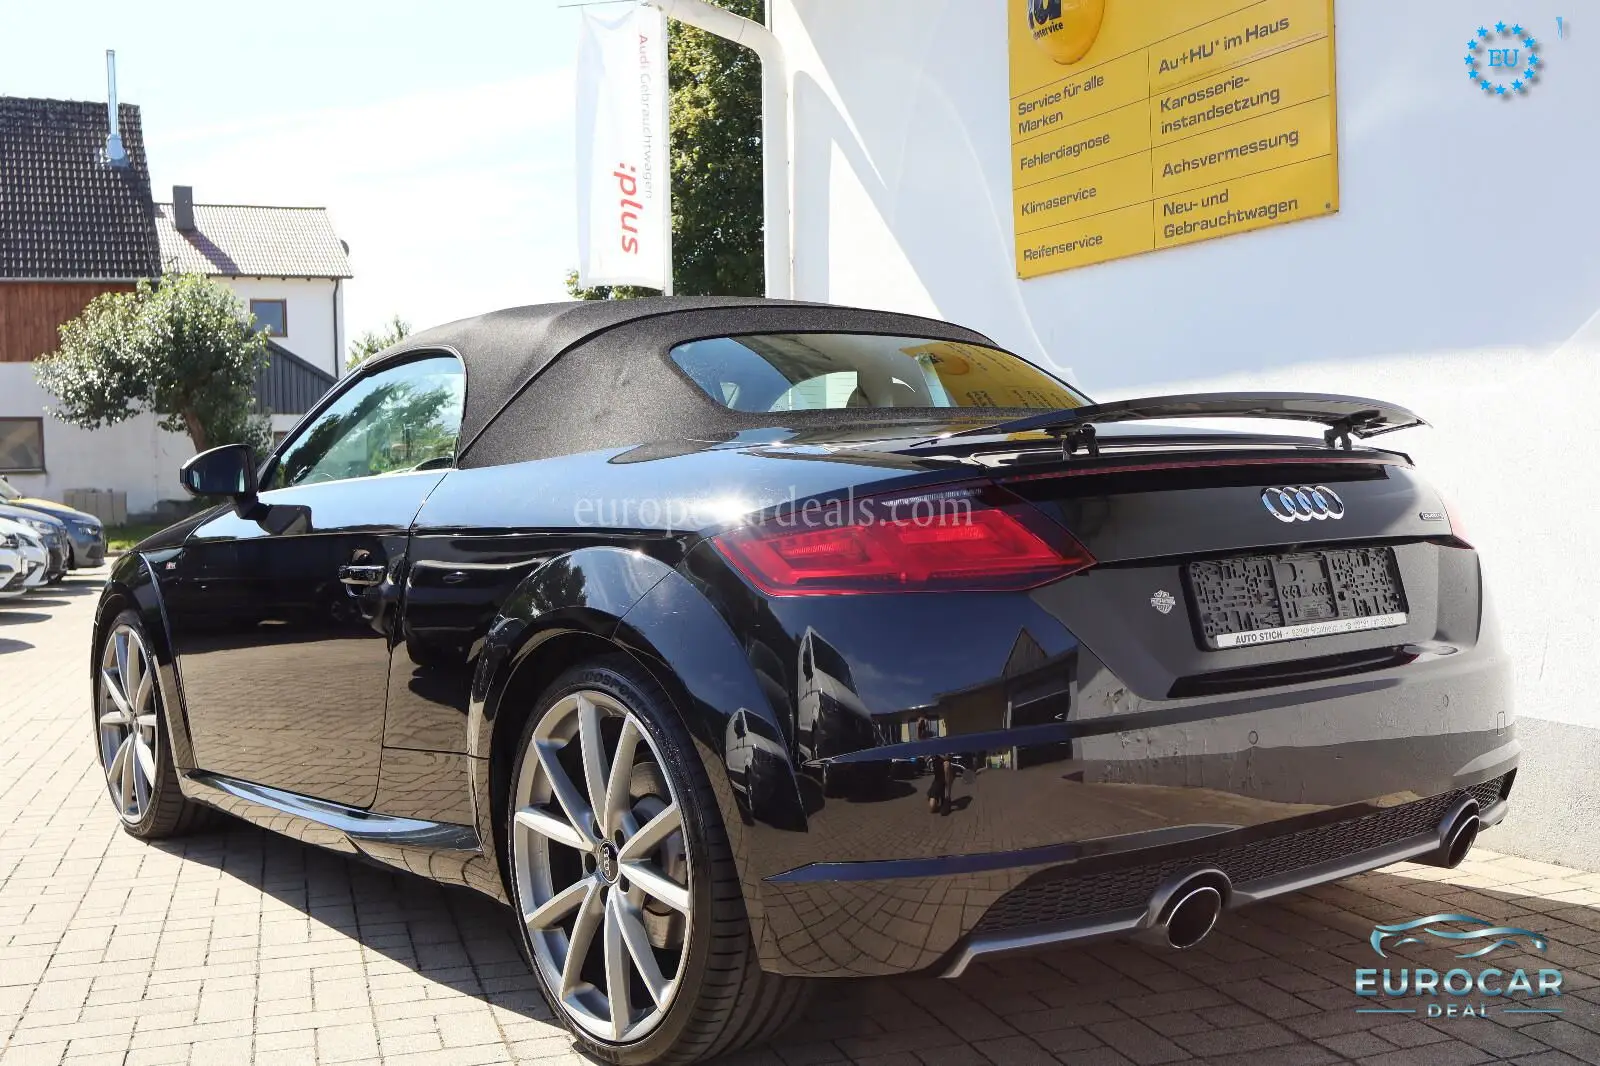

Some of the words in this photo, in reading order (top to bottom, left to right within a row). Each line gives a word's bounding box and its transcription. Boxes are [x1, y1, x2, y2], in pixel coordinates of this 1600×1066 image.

[638, 34, 649, 69] Audi
[1223, 36, 1242, 51] im
[1245, 17, 1289, 42] Haus
[1018, 92, 1062, 116] Service
[1063, 83, 1082, 99] für
[1083, 75, 1104, 92] alle
[1160, 75, 1250, 113] Karosserie-
[1161, 88, 1280, 135] instandsetzung
[640, 73, 653, 199] Gebrauchtwagen
[1018, 111, 1063, 135] Marken
[1020, 133, 1110, 171] Fehlerdiagnose
[1162, 128, 1299, 178] Achsvermessung
[1021, 187, 1097, 216] Klimaservice
[1163, 201, 1199, 217] Neu-
[1201, 188, 1229, 208] und
[1164, 199, 1299, 239] Gebrauchtwagen
[1023, 234, 1103, 262] Reifenservice
[1235, 633, 1257, 645] AUTO
[1259, 630, 1283, 642] STICH
